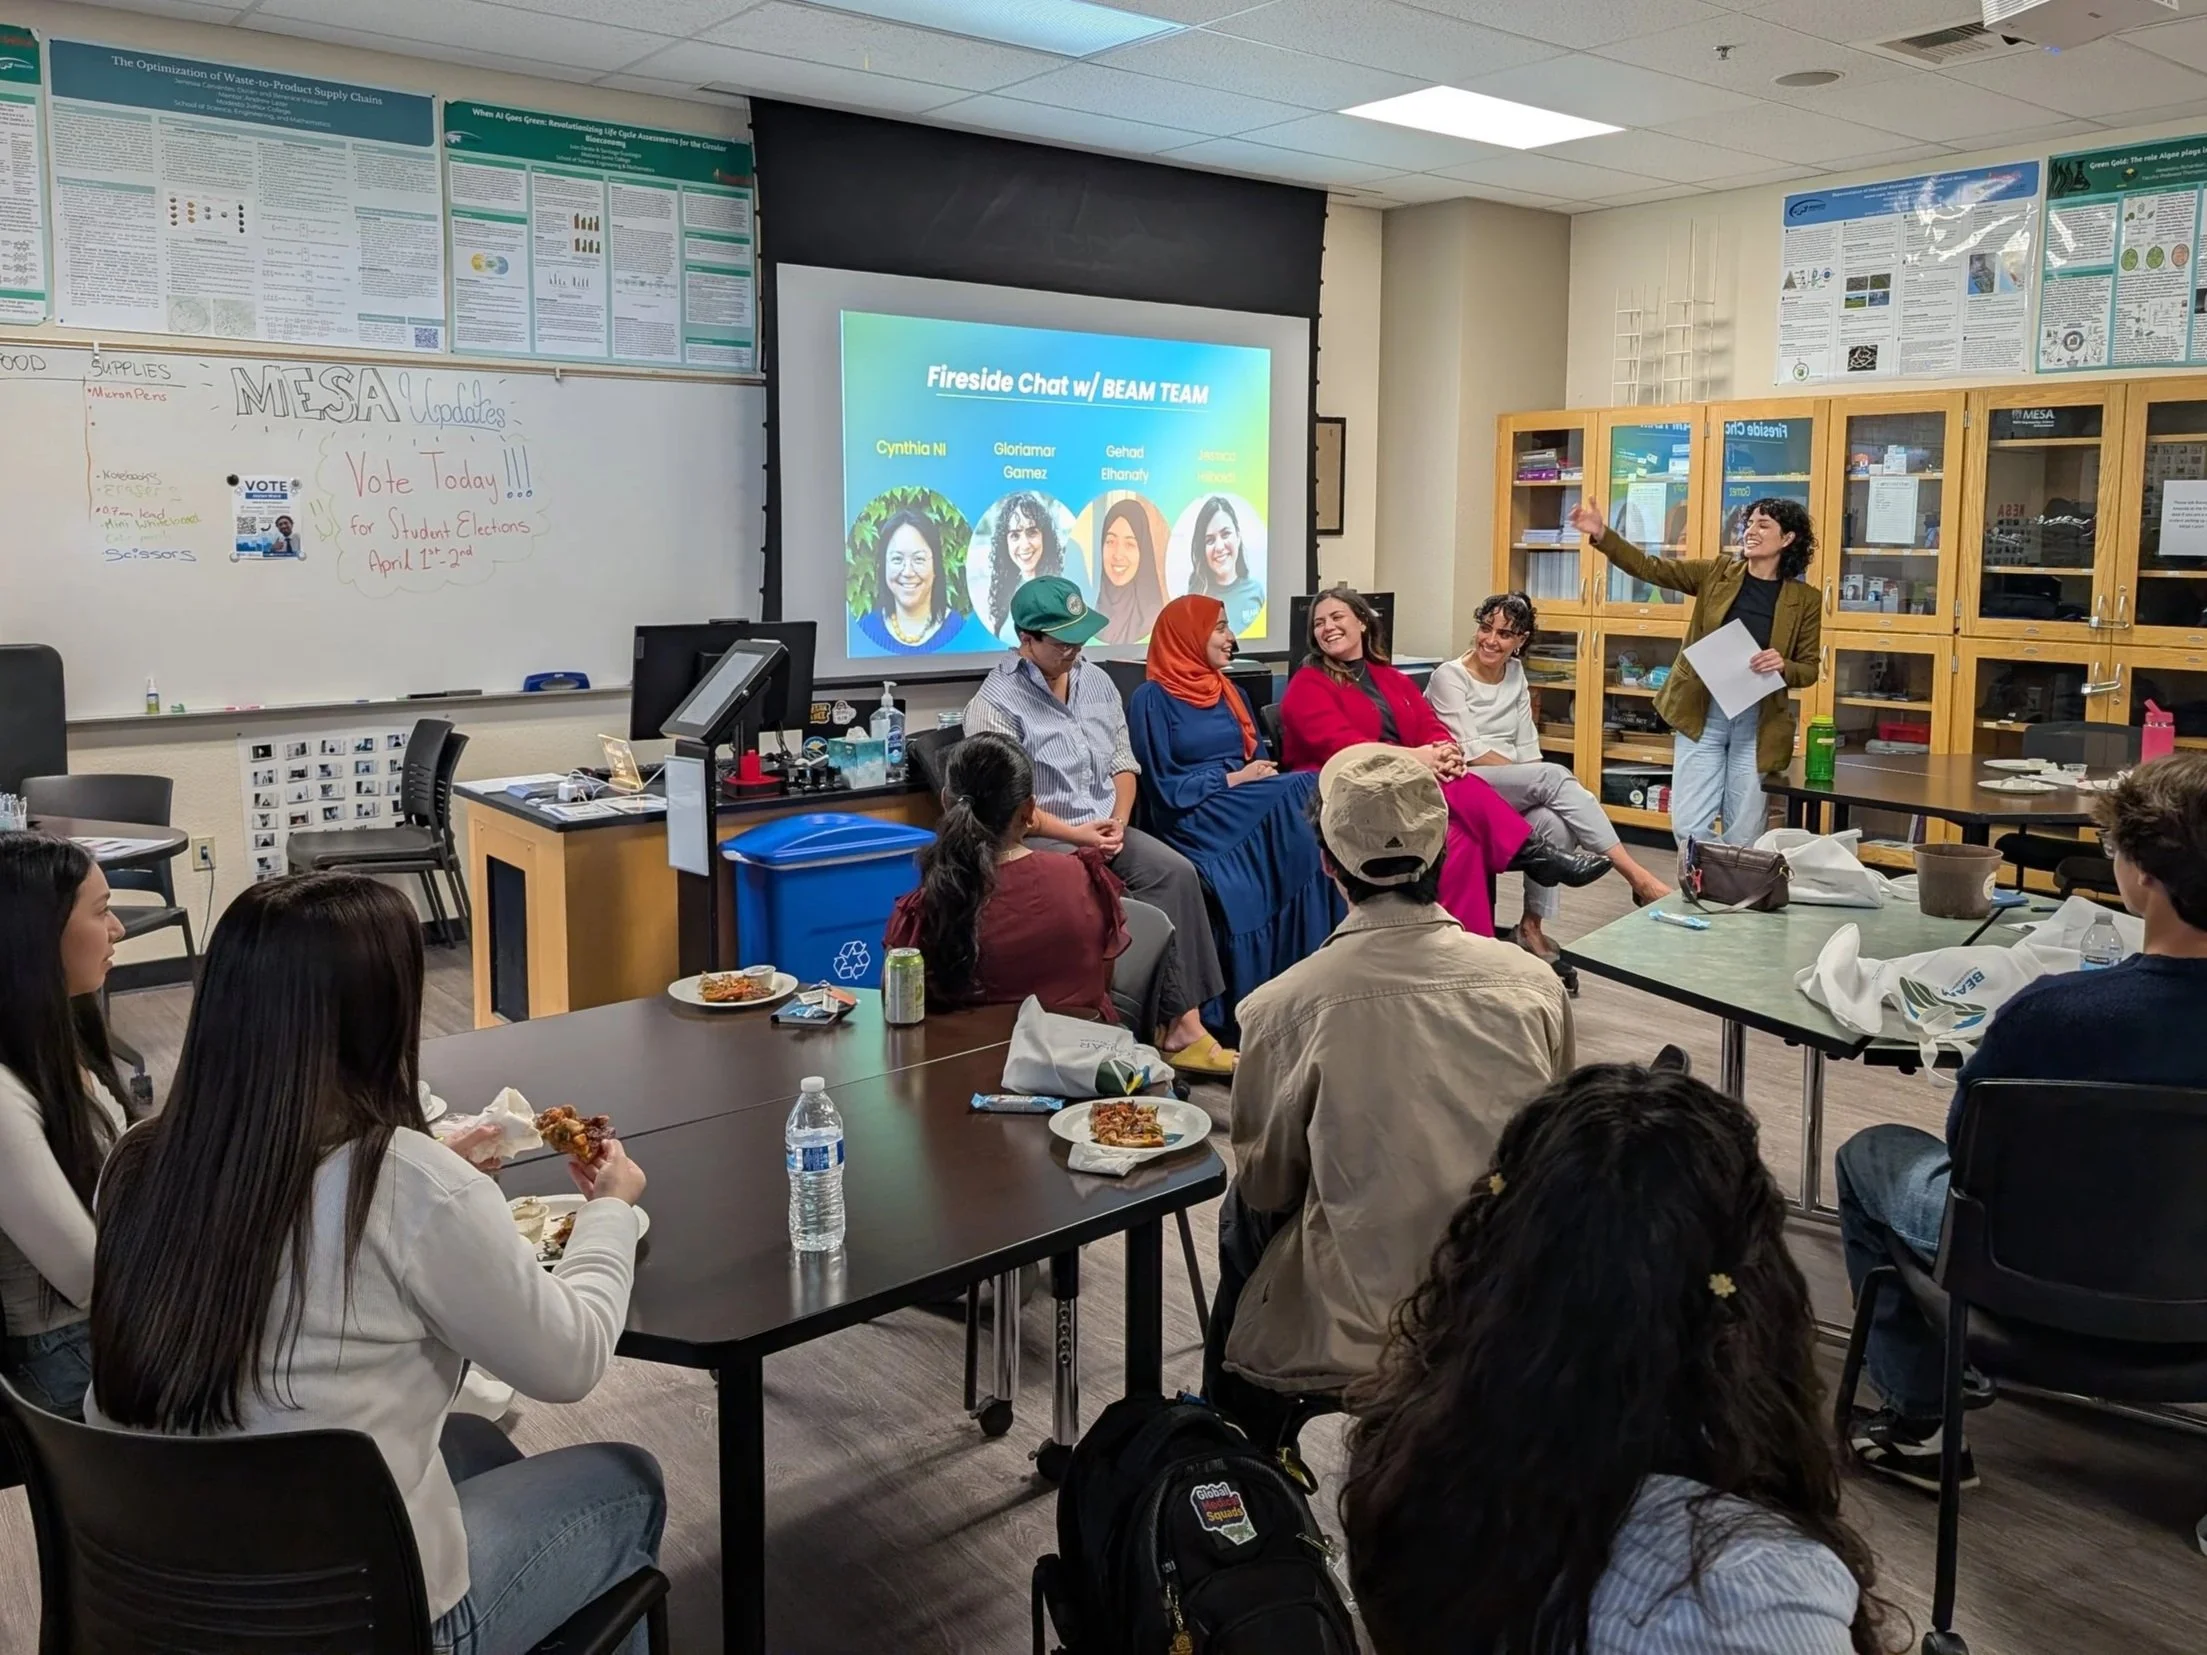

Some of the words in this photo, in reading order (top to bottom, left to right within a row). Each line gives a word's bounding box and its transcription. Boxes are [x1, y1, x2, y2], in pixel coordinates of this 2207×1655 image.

[111, 55, 134, 68] The
[136, 59, 208, 80] Optimization
[210, 71, 222, 81] of
[223, 72, 312, 95] Waste-to-Product
[314, 87, 348, 102] Supply
[350, 92, 383, 105] Chains
[174, 99, 198, 109] School
[472, 107, 494, 119] When
[505, 113, 522, 123] Goes
[523, 116, 548, 126] Green:
[548, 119, 603, 135] Revolutionizing
[604, 126, 618, 137] Life
[618, 129, 637, 140] Cycle
[637, 132, 679, 146] Assessments
[679, 138, 689, 148] for
[690, 139, 701, 149] the
[702, 142, 727, 153] Circular
[585, 135, 627, 149] Bioeconomy
[2089, 161, 2110, 170] Green
[2110, 157, 2130, 168] Gold:
[2130, 156, 2143, 164] The
[2144, 153, 2158, 162] role
[2158, 150, 2180, 161] Algae
[2181, 147, 2201, 159] plays
[0, 354, 46, 371] OOD
[91, 358, 172, 380] SUPPLIES
[927, 364, 1014, 393] Fireside
[1018, 372, 1069, 396] Chat
[1073, 371, 1100, 403] w/
[1102, 378, 1156, 402] BEAM
[1160, 382, 1209, 405] TEAM
[134, 387, 168, 402] Pens
[231, 365, 401, 423] MESA
[398, 371, 508, 430] Updates
[2023, 409, 2055, 420] MESA
[876, 439, 930, 459] Cynthia
[993, 442, 1056, 458] Gloriamar
[1106, 445, 1144, 459] Gehad
[345, 451, 413, 497] Vote
[1003, 465, 1048, 480] Gamez
[1101, 467, 1149, 484] Elhanafy
[244, 480, 288, 492] VOTE
[350, 514, 375, 536] for
[388, 506, 450, 540] Student
[457, 510, 531, 539] Elections
[105, 548, 197, 562] Scissors
[368, 548, 413, 578] April
[1196, 1486, 1229, 1500] Global
[1206, 1506, 1244, 1522] Squads
